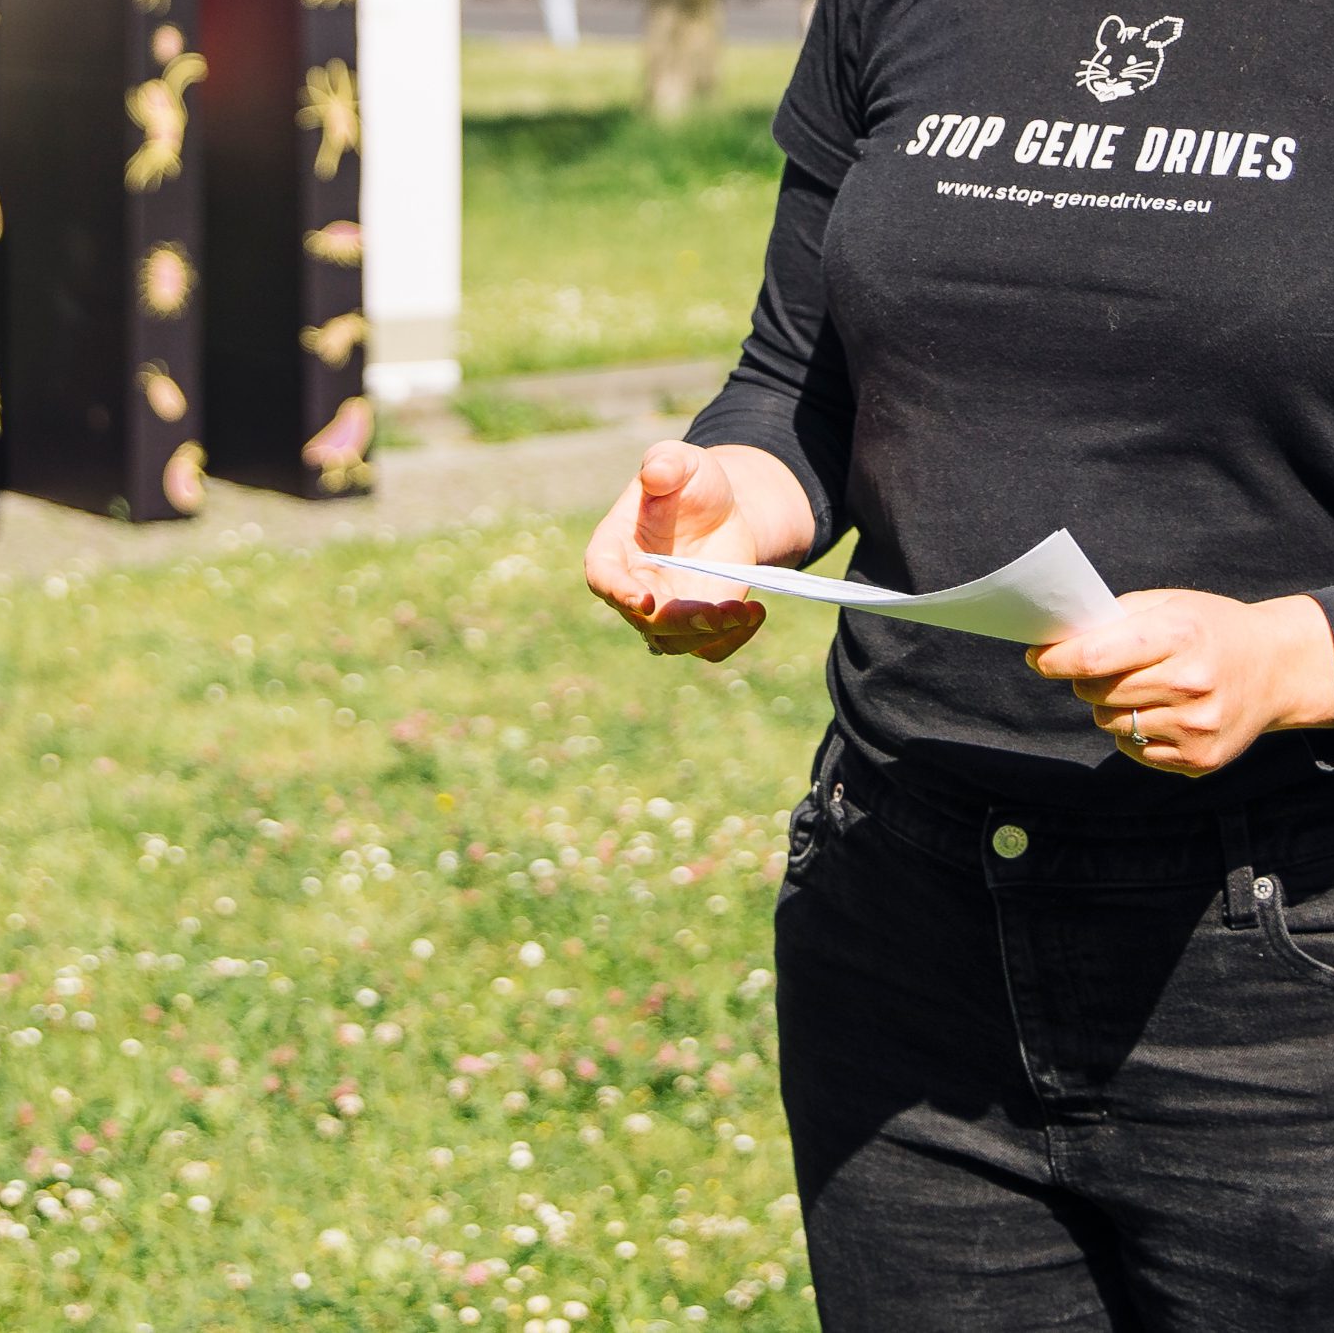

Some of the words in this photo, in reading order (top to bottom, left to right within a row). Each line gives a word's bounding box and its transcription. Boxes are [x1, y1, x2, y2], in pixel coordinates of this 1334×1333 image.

[905, 114, 1006, 161] STOP
[1014, 119, 1126, 171] GENE
[1134, 126, 1298, 181] DRIVES
[936, 180, 1212, 214] www.stop-genedrives.eu
